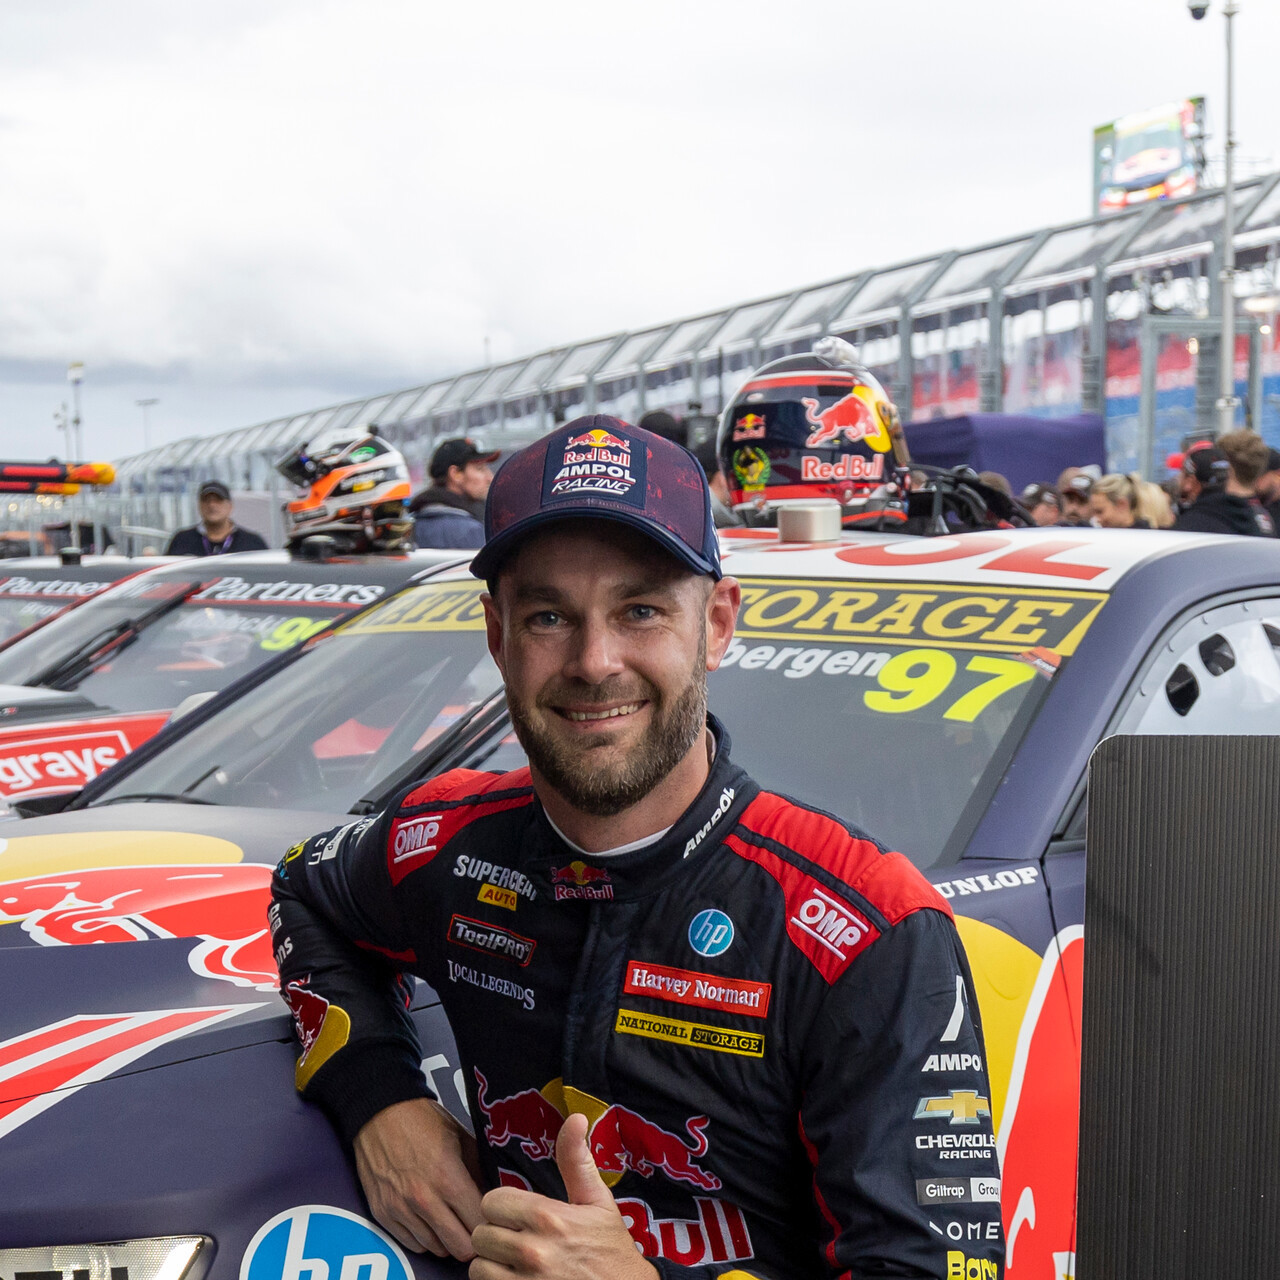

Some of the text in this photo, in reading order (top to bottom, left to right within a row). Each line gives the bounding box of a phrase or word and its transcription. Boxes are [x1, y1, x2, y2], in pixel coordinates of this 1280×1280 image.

[563, 448, 631, 468] Red Bull
[801, 455, 851, 480] Red
[551, 477, 633, 493] RACING
[554, 463, 637, 484] AMPOL
[719, 638, 1037, 723] bergen 97
[394, 821, 440, 853] OMP
[683, 787, 735, 859] AMPOL
[555, 884, 614, 901] Red Bull
[933, 866, 1039, 899] UNLOP
[484, 888, 516, 907] AUTO
[694, 910, 730, 955] hp
[799, 898, 862, 948] OMP
[480, 973, 536, 1011] LEGENDS
[631, 967, 760, 1008] Harvey Norman
[619, 1014, 760, 1052] NATIONAL STORAGE
[915, 1133, 996, 1150] CHEVROLE
[938, 1149, 992, 1160] RACING
[925, 1183, 966, 1199] Giltrap
